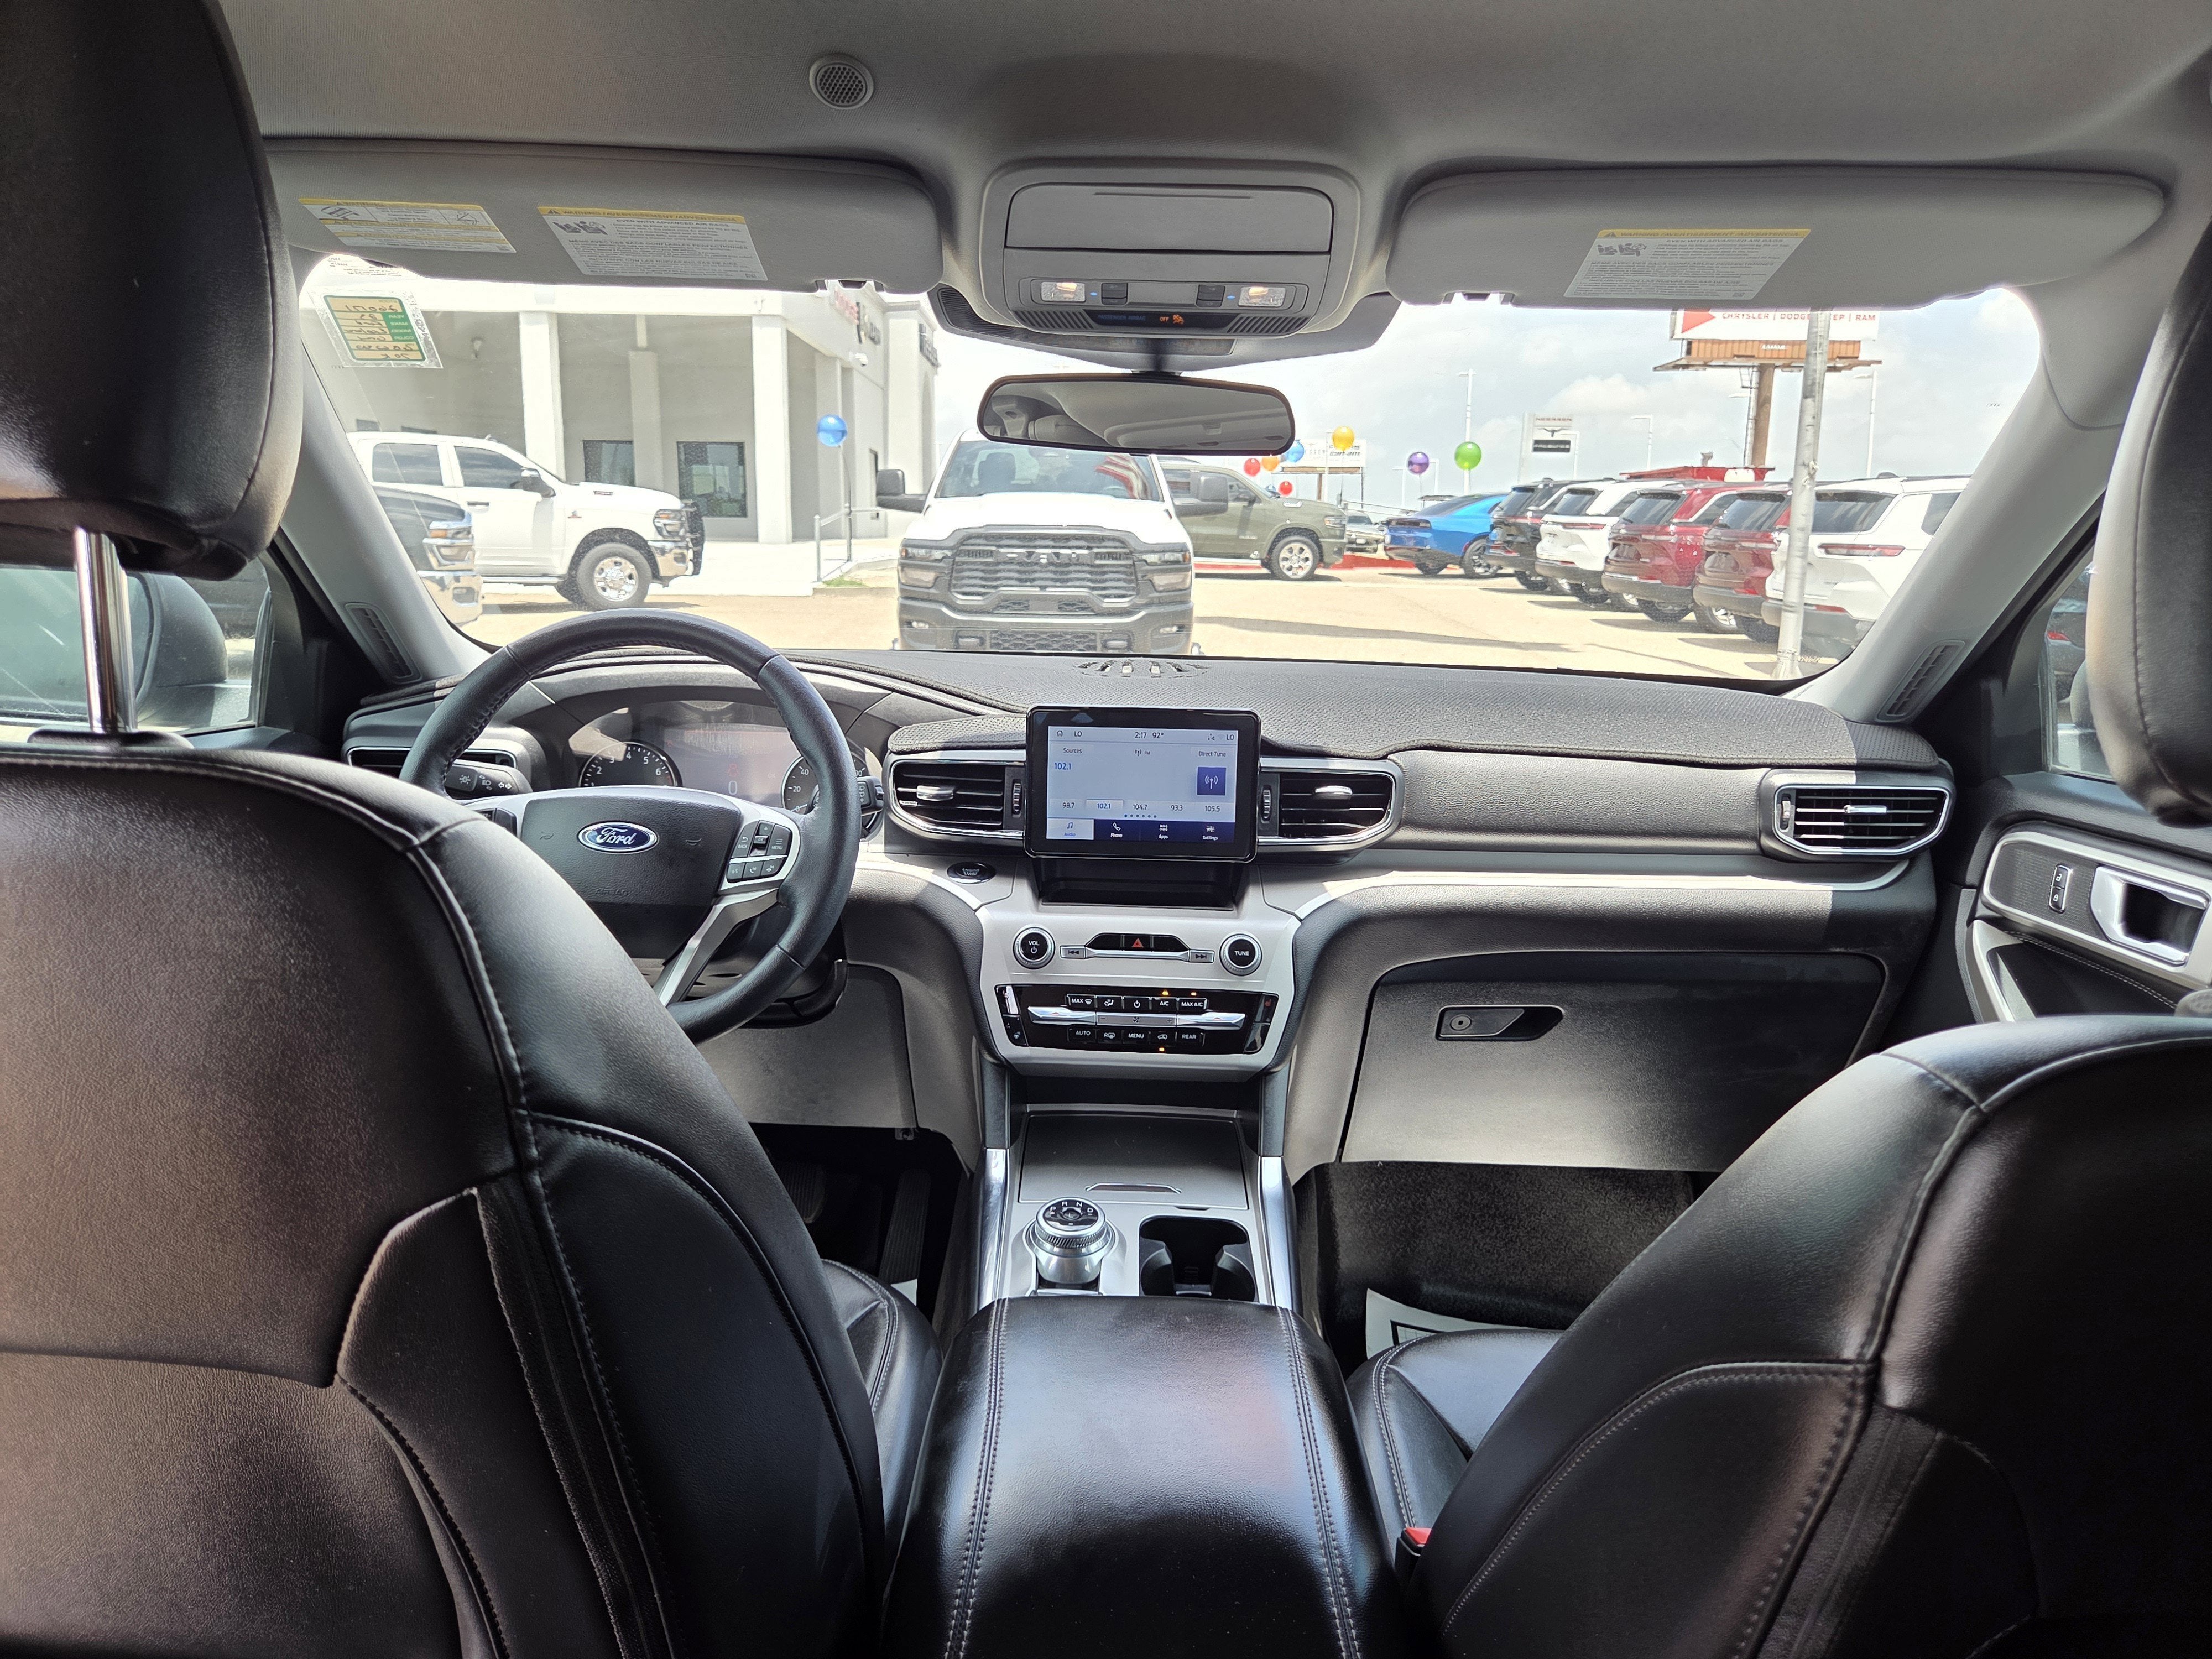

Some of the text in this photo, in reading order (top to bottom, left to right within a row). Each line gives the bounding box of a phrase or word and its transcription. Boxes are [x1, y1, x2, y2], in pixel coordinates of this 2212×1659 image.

[643, 756, 649, 764] 5
[655, 768, 661, 776] 6
[728, 780, 738, 795] 0
[596, 827, 637, 845] Ford
